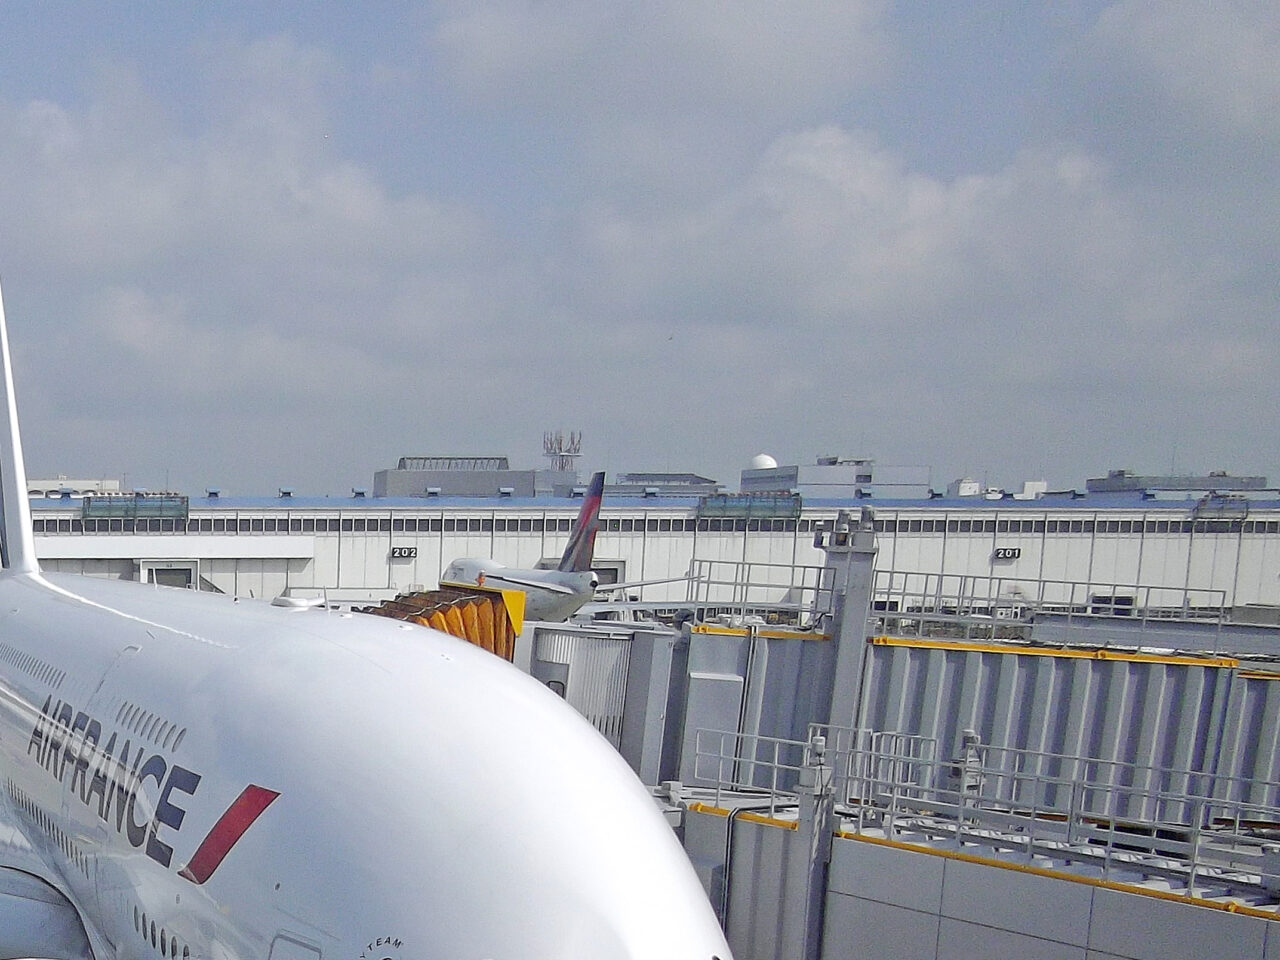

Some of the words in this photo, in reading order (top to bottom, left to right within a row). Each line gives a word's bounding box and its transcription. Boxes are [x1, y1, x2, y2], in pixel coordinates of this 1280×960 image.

[393, 548, 416, 557] 202
[997, 549, 1019, 558] 201
[28, 694, 202, 869] AIRFRANCE
